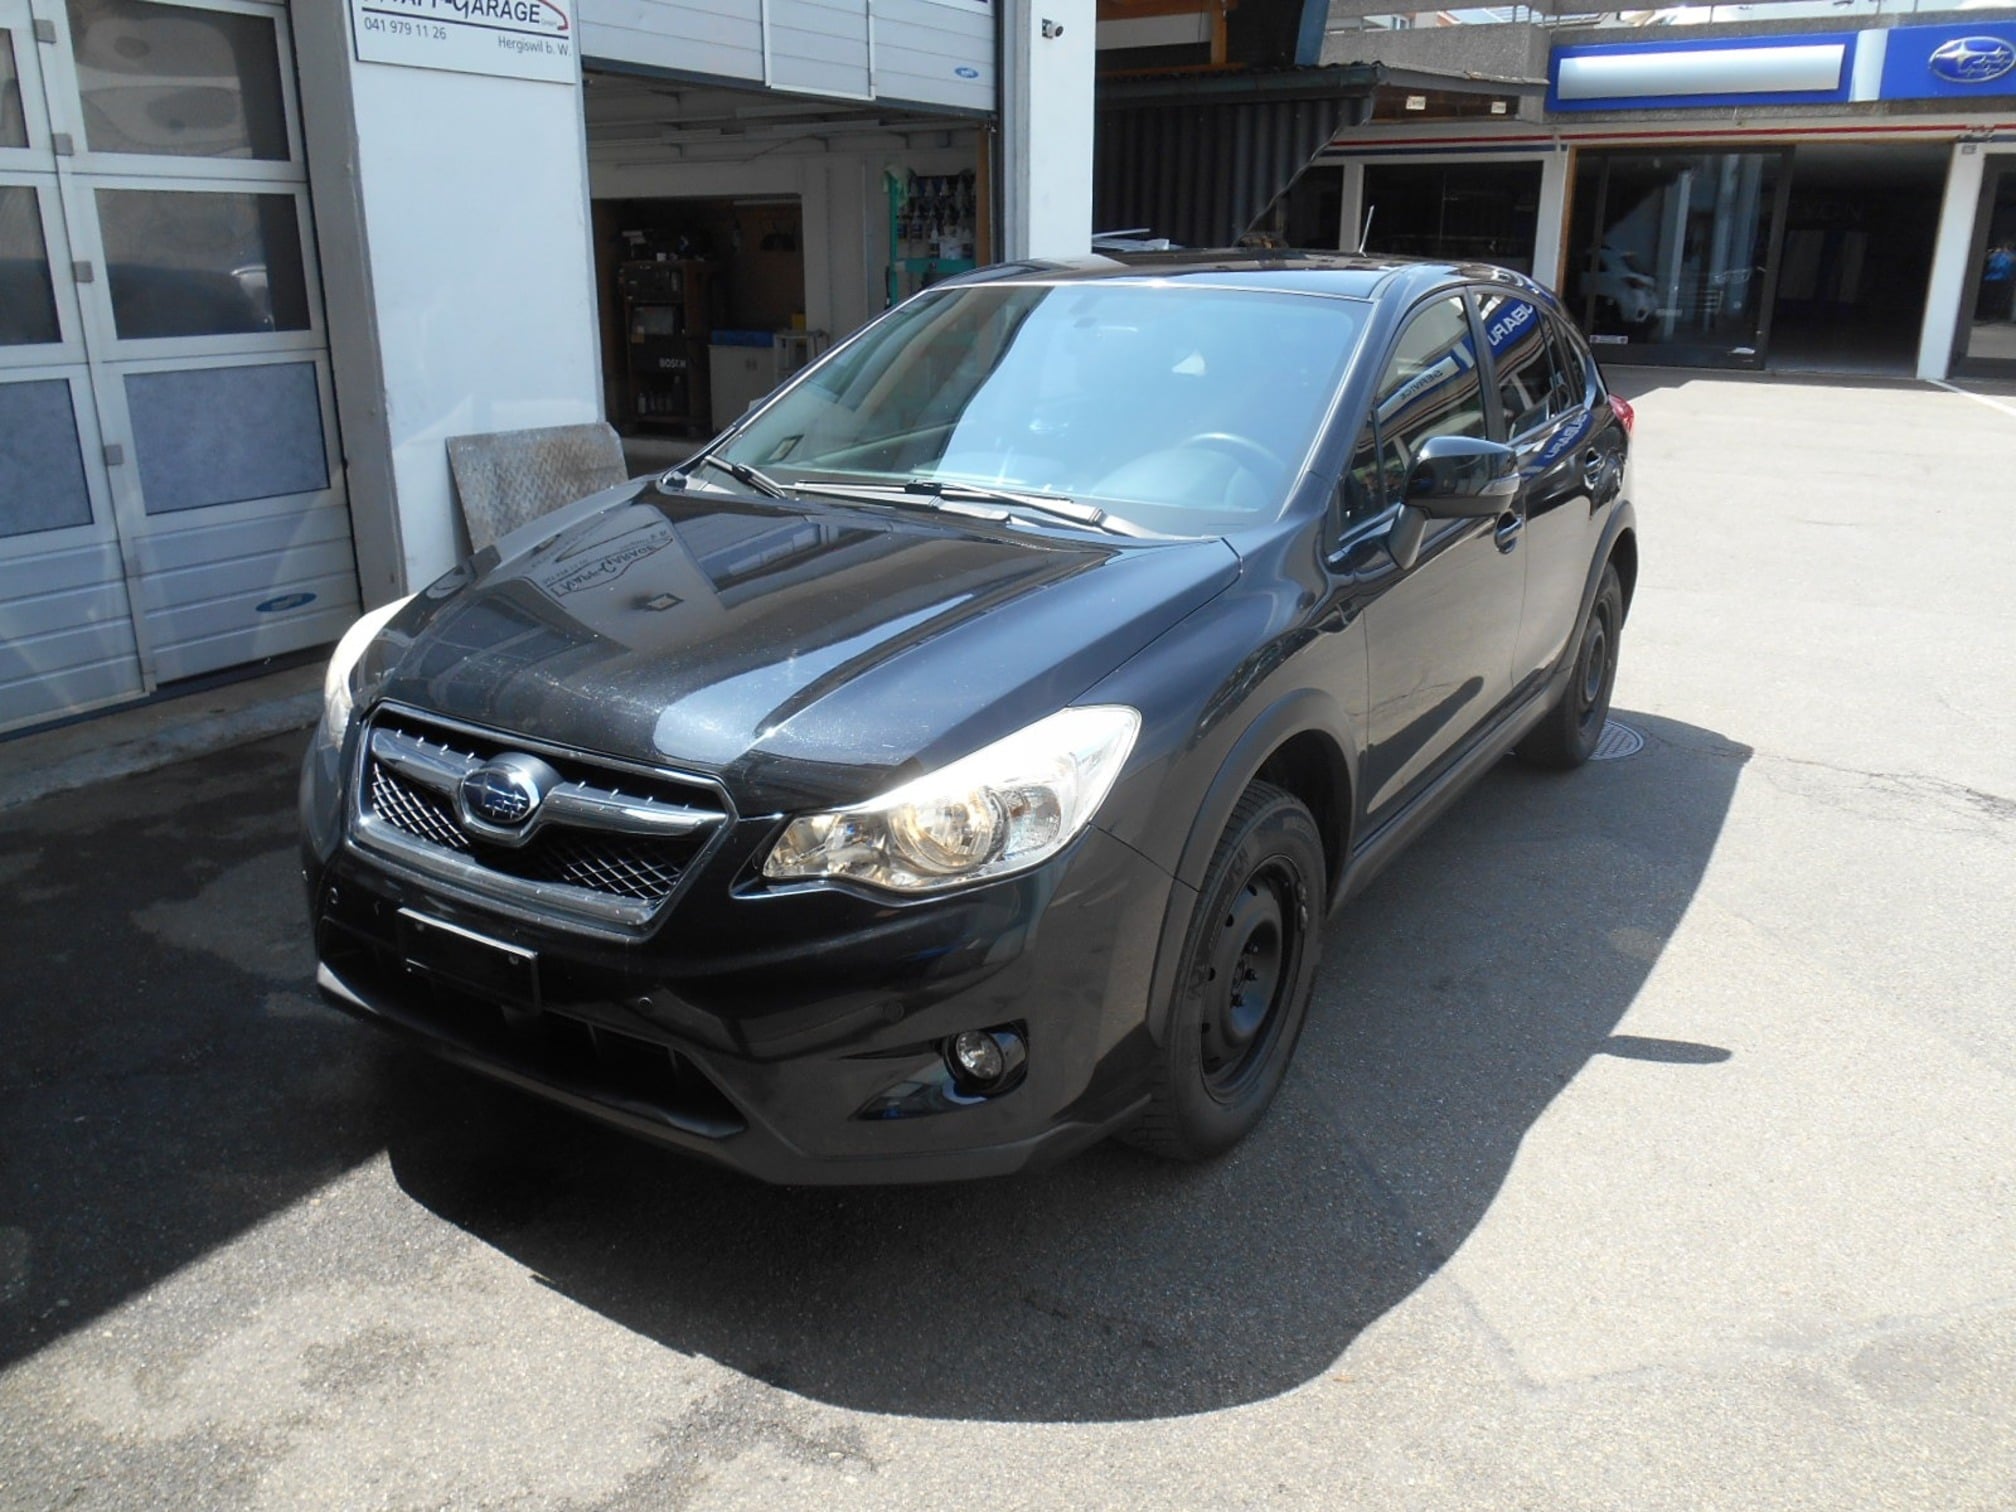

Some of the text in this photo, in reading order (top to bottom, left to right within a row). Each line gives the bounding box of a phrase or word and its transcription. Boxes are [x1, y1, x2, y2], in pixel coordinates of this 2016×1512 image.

[364, 17, 447, 40] 041 979 11 26
[497, 35, 544, 54] Hergiswil
